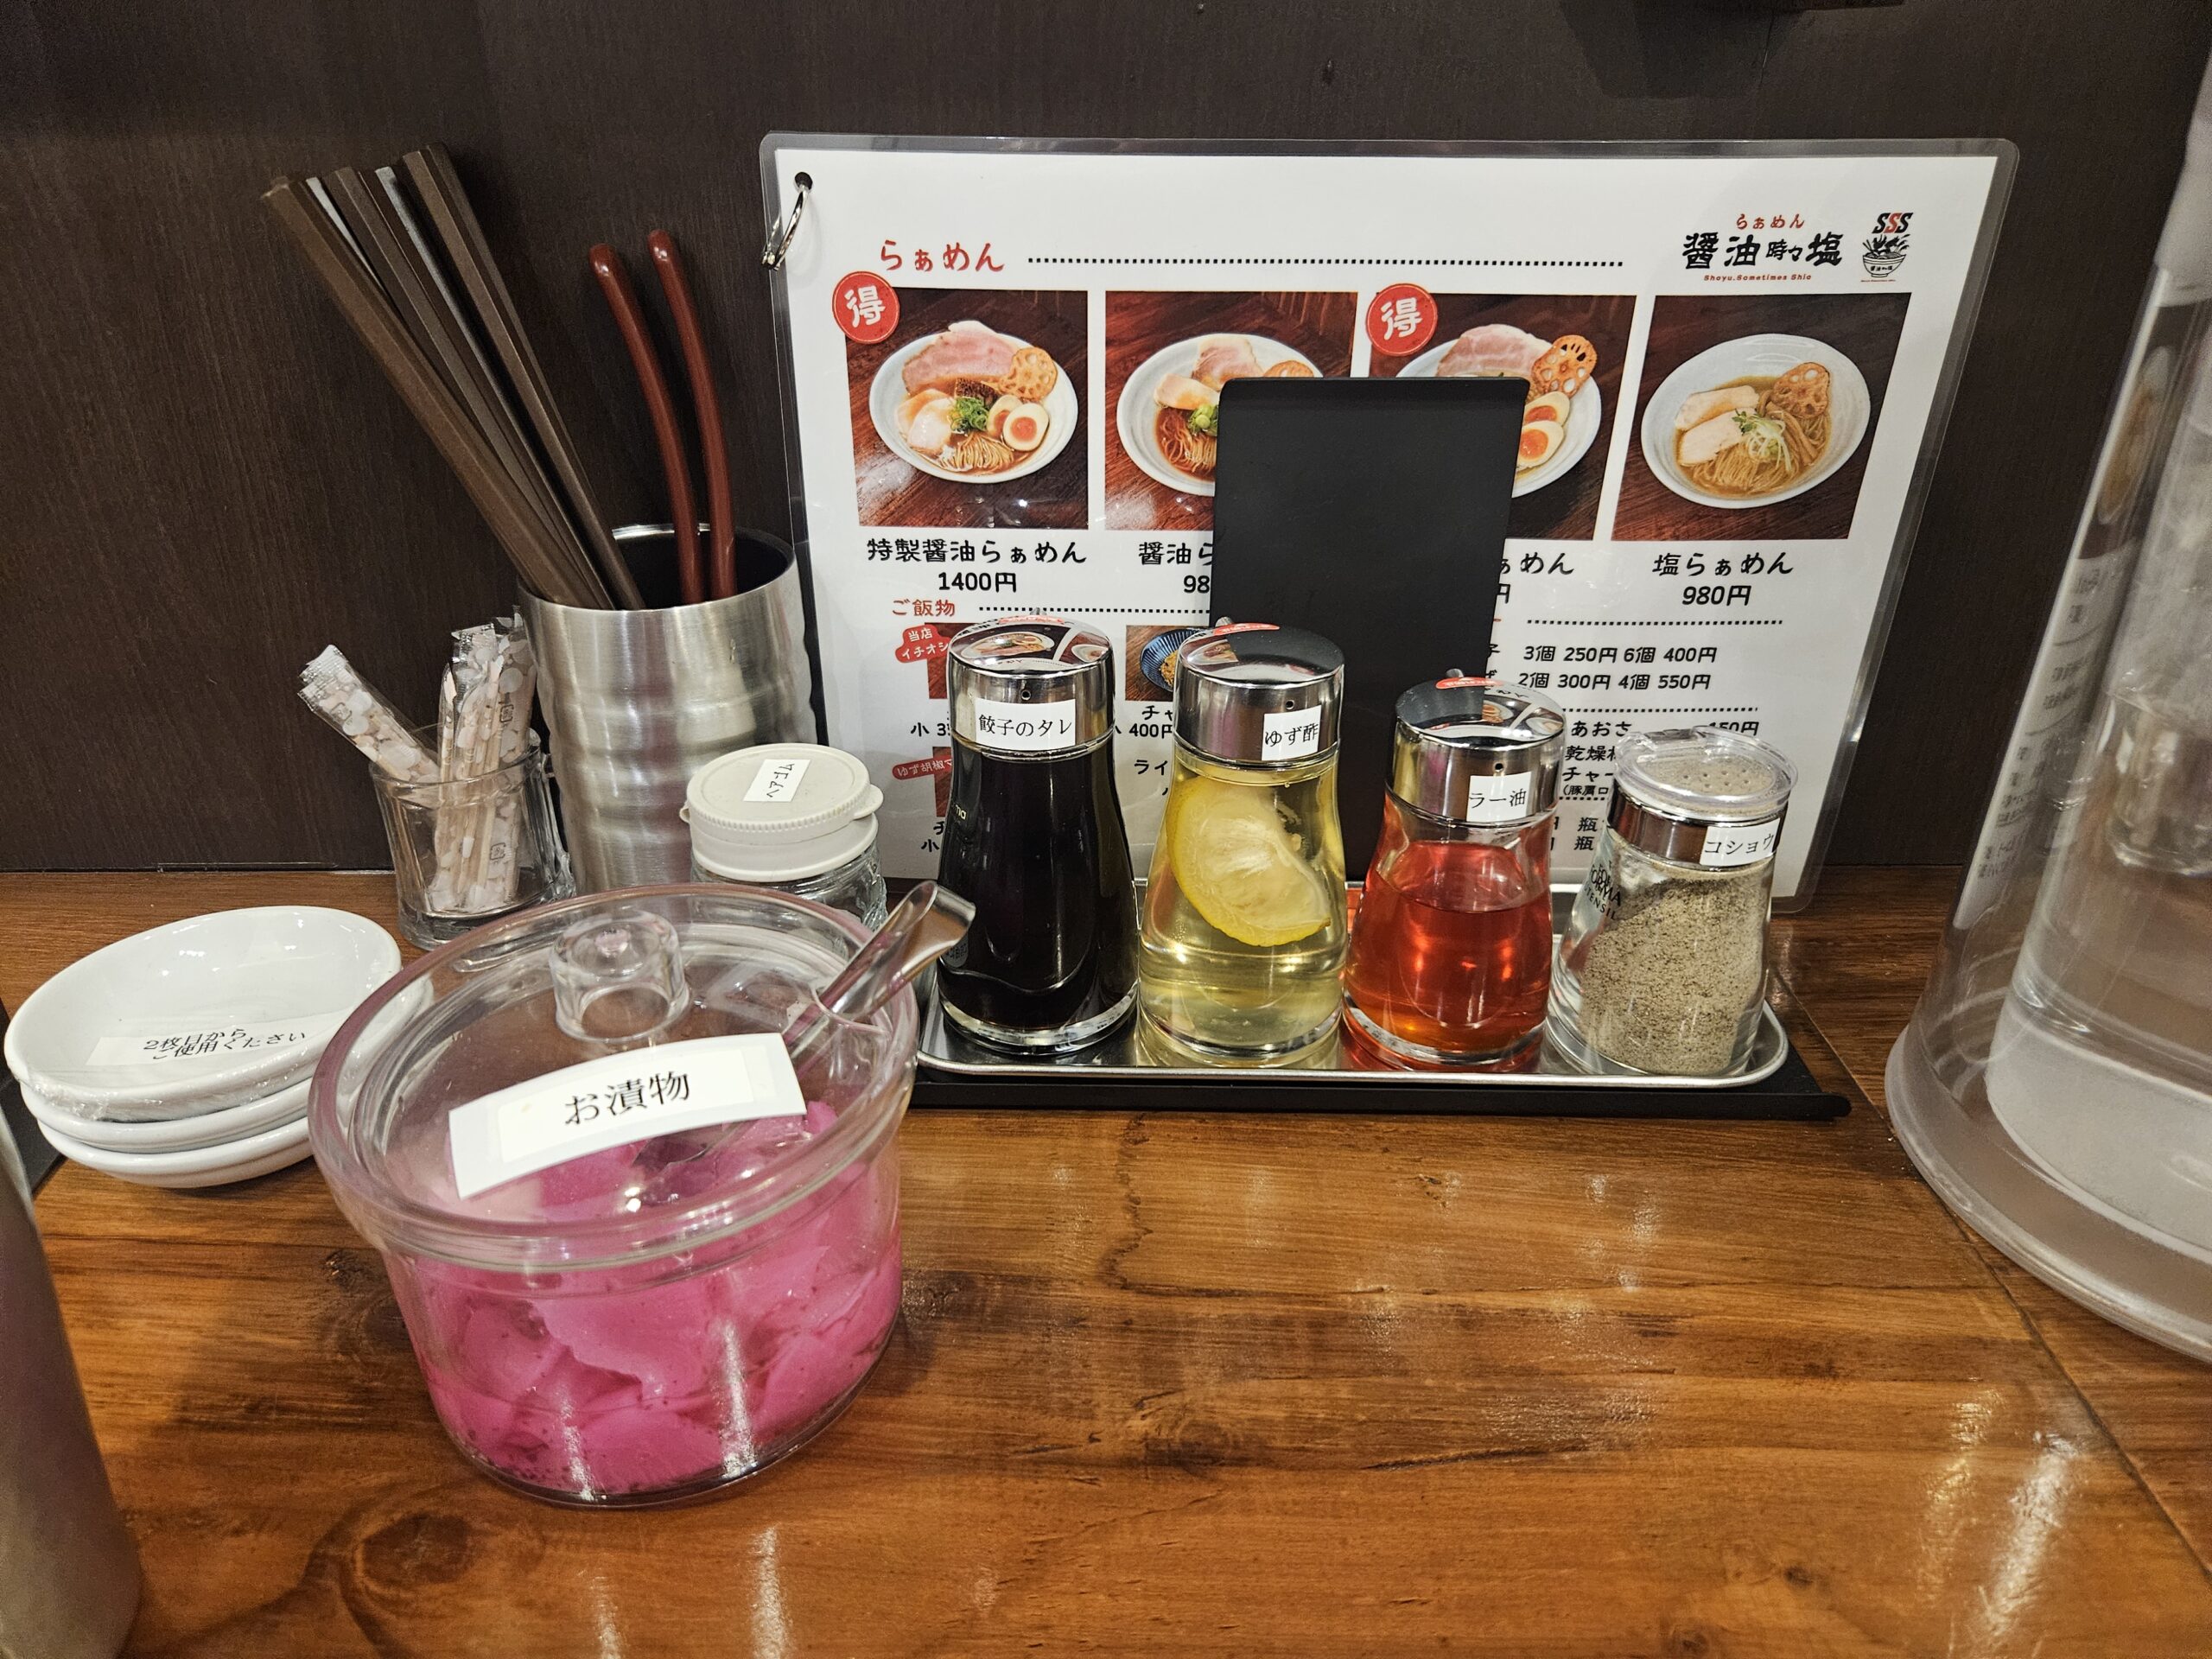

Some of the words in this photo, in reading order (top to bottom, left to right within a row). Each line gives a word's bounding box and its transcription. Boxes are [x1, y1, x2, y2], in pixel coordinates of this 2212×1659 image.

[1736, 213, 1805, 230] らぁめん
[1872, 213, 1913, 233] SSS
[880, 239, 1005, 272] らぁめん
[1682, 232, 1843, 270] 醤油時々塩
[844, 284, 886, 328] 得
[1380, 297, 1423, 340] 得
[867, 537, 1087, 563] 特製醤油らぁめん
[1651, 551, 1794, 576] 塩らぁめん
[938, 571, 1017, 593] 1400円
[1681, 585, 1752, 607] 980円
[892, 600, 956, 617] ご飯物
[908, 626, 933, 642] 当店
[902, 642, 949, 661] イチオシ
[1523, 645, 1556, 662] 3個
[1563, 647, 1618, 664] 250円
[1624, 646, 1656, 664] 6個
[1663, 646, 1717, 664] 400円
[1518, 672, 1550, 689] 2個
[1557, 674, 1611, 690] 300円
[1618, 673, 1650, 690] 4個
[1657, 674, 1712, 690] 550円
[911, 721, 930, 737] 小
[978, 714, 1072, 737] 餃子のタレ
[1264, 723, 1319, 747] ゆず酢
[766, 763, 795, 798] ヘアゴム
[1469, 788, 1527, 809] ラー油
[1704, 833, 1775, 855] コショウ
[143, 1028, 246, 1051] 2枚目から
[564, 1071, 690, 1126] お漬物
